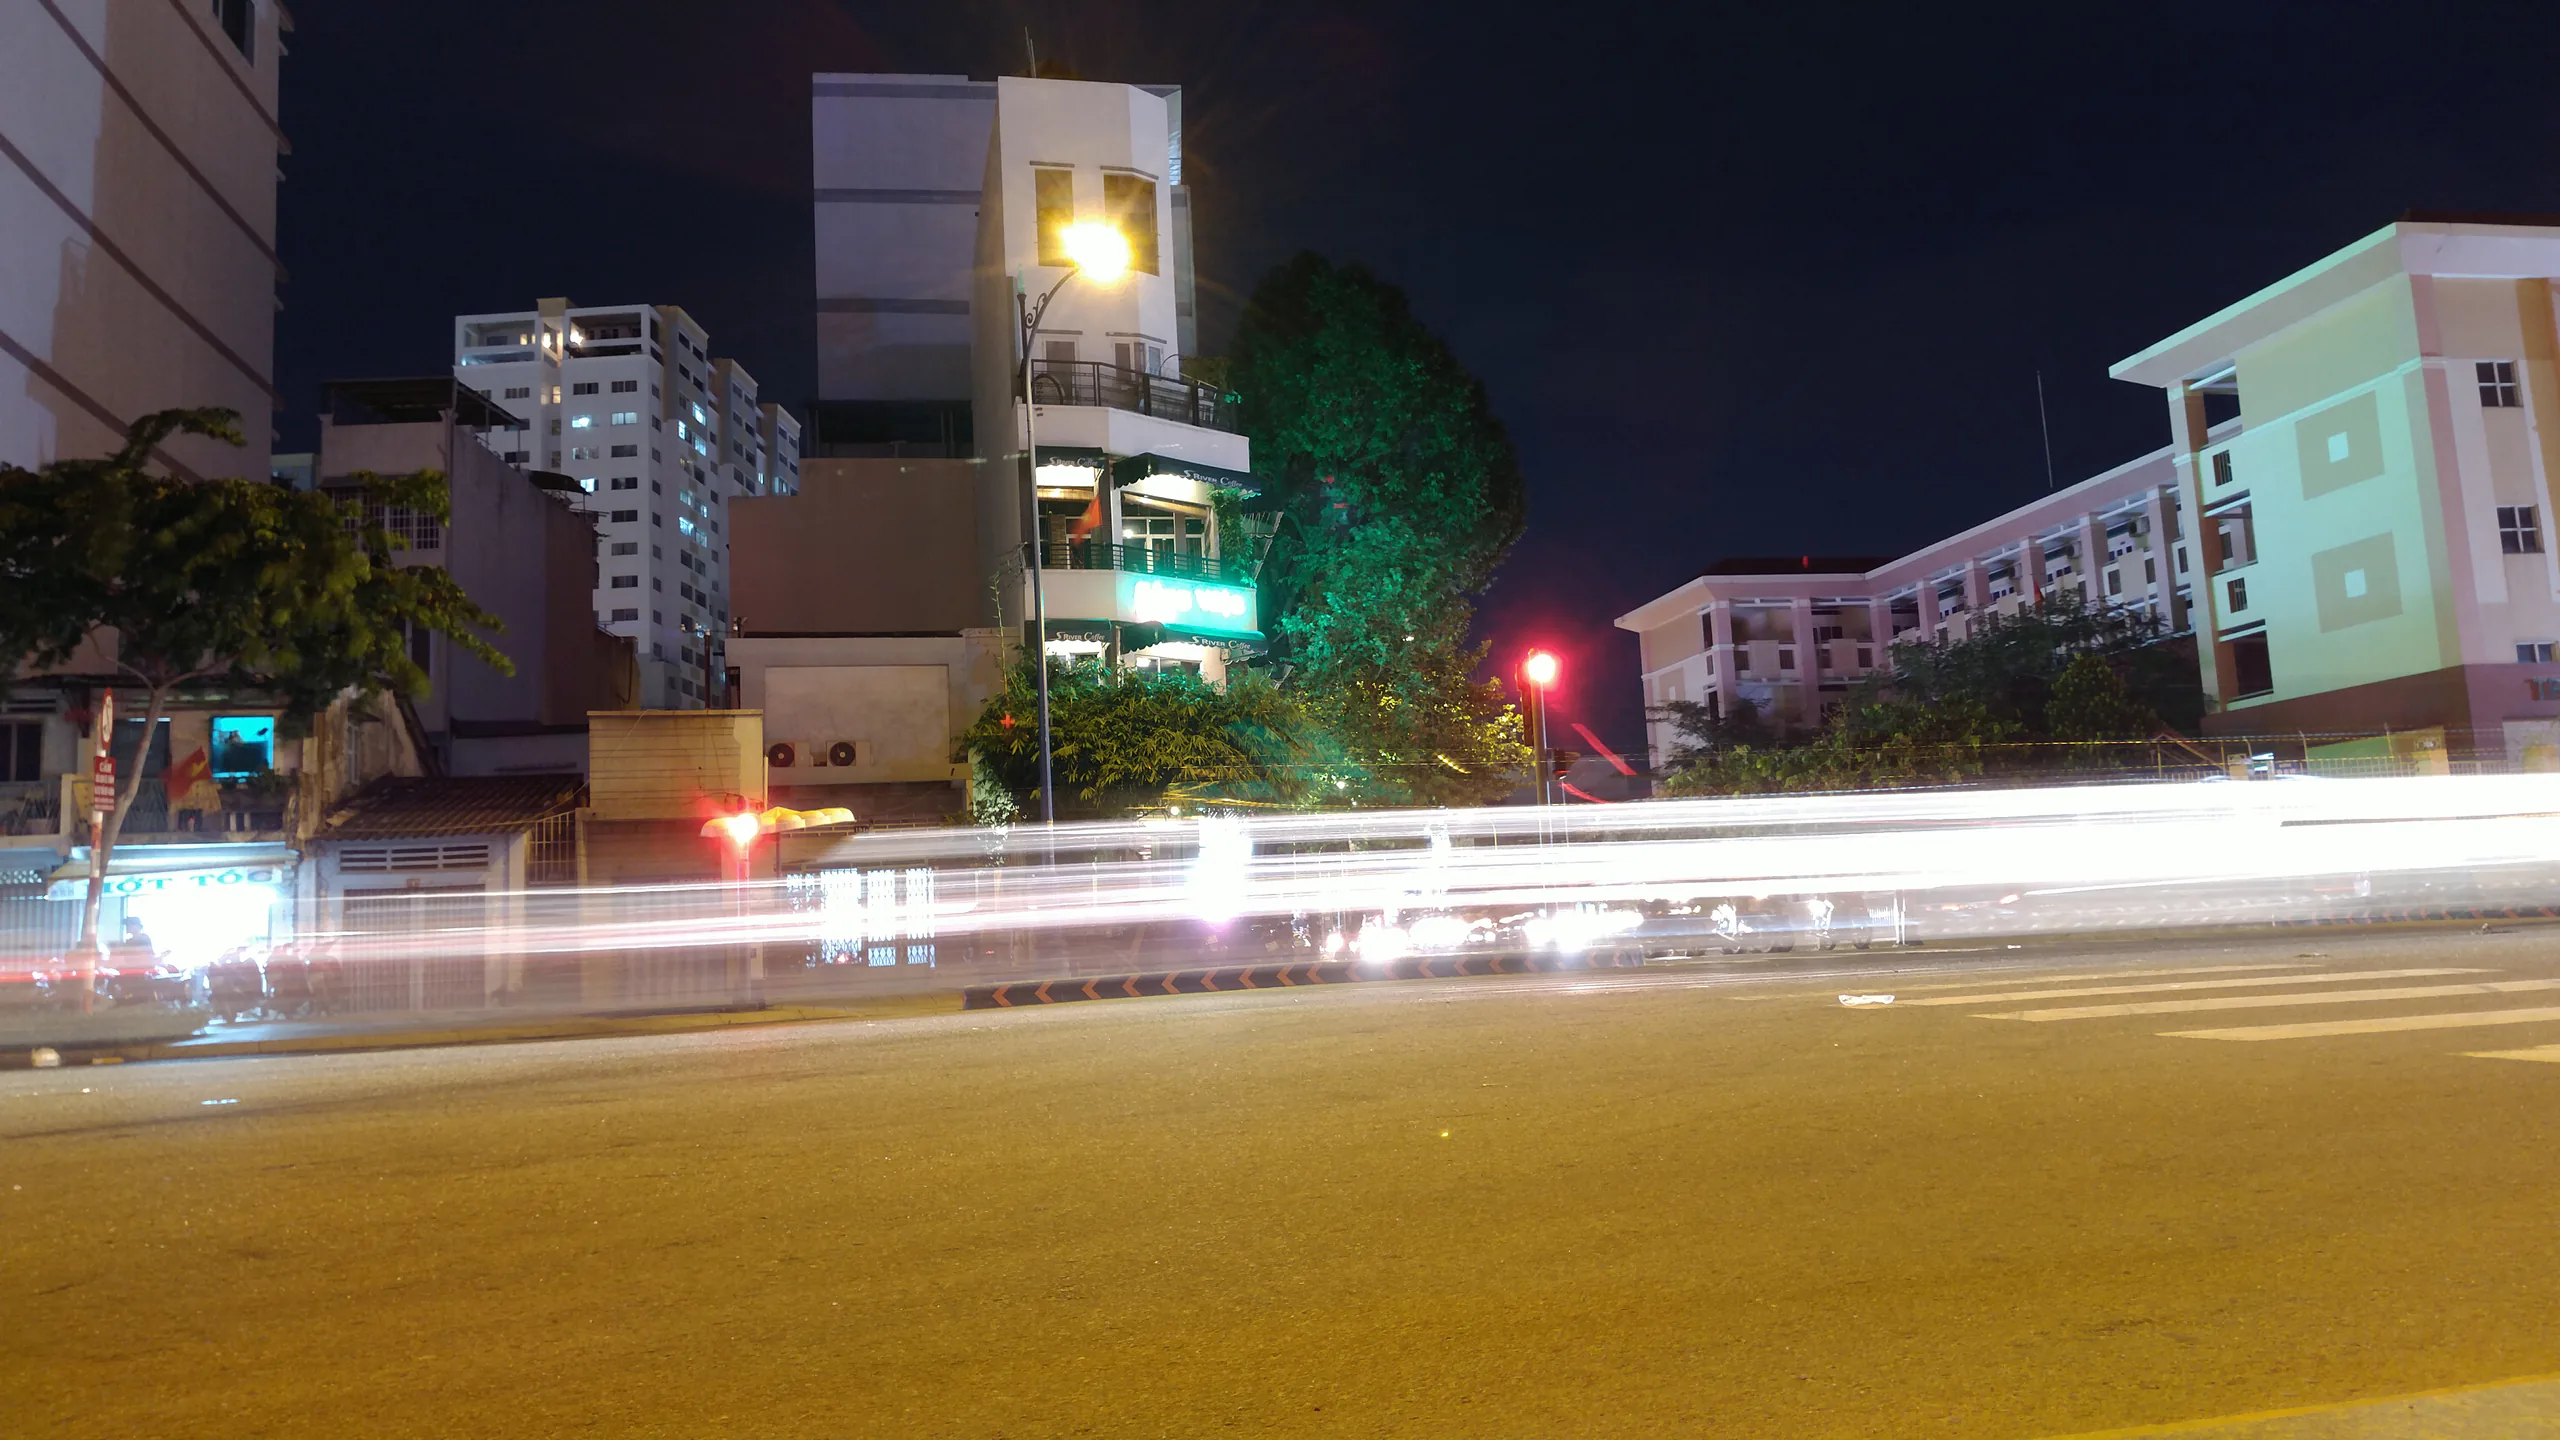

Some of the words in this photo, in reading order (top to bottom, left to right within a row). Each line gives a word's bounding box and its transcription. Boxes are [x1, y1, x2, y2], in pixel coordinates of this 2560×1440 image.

[1077, 457, 1098, 467] Coffee
[1193, 473, 1217, 483] RIVER
[1220, 477, 1243, 487] Coffee
[1084, 631, 1105, 641] Coffee
[1201, 638, 1226, 647] RIVER
[1228, 640, 1251, 649] Coffee
